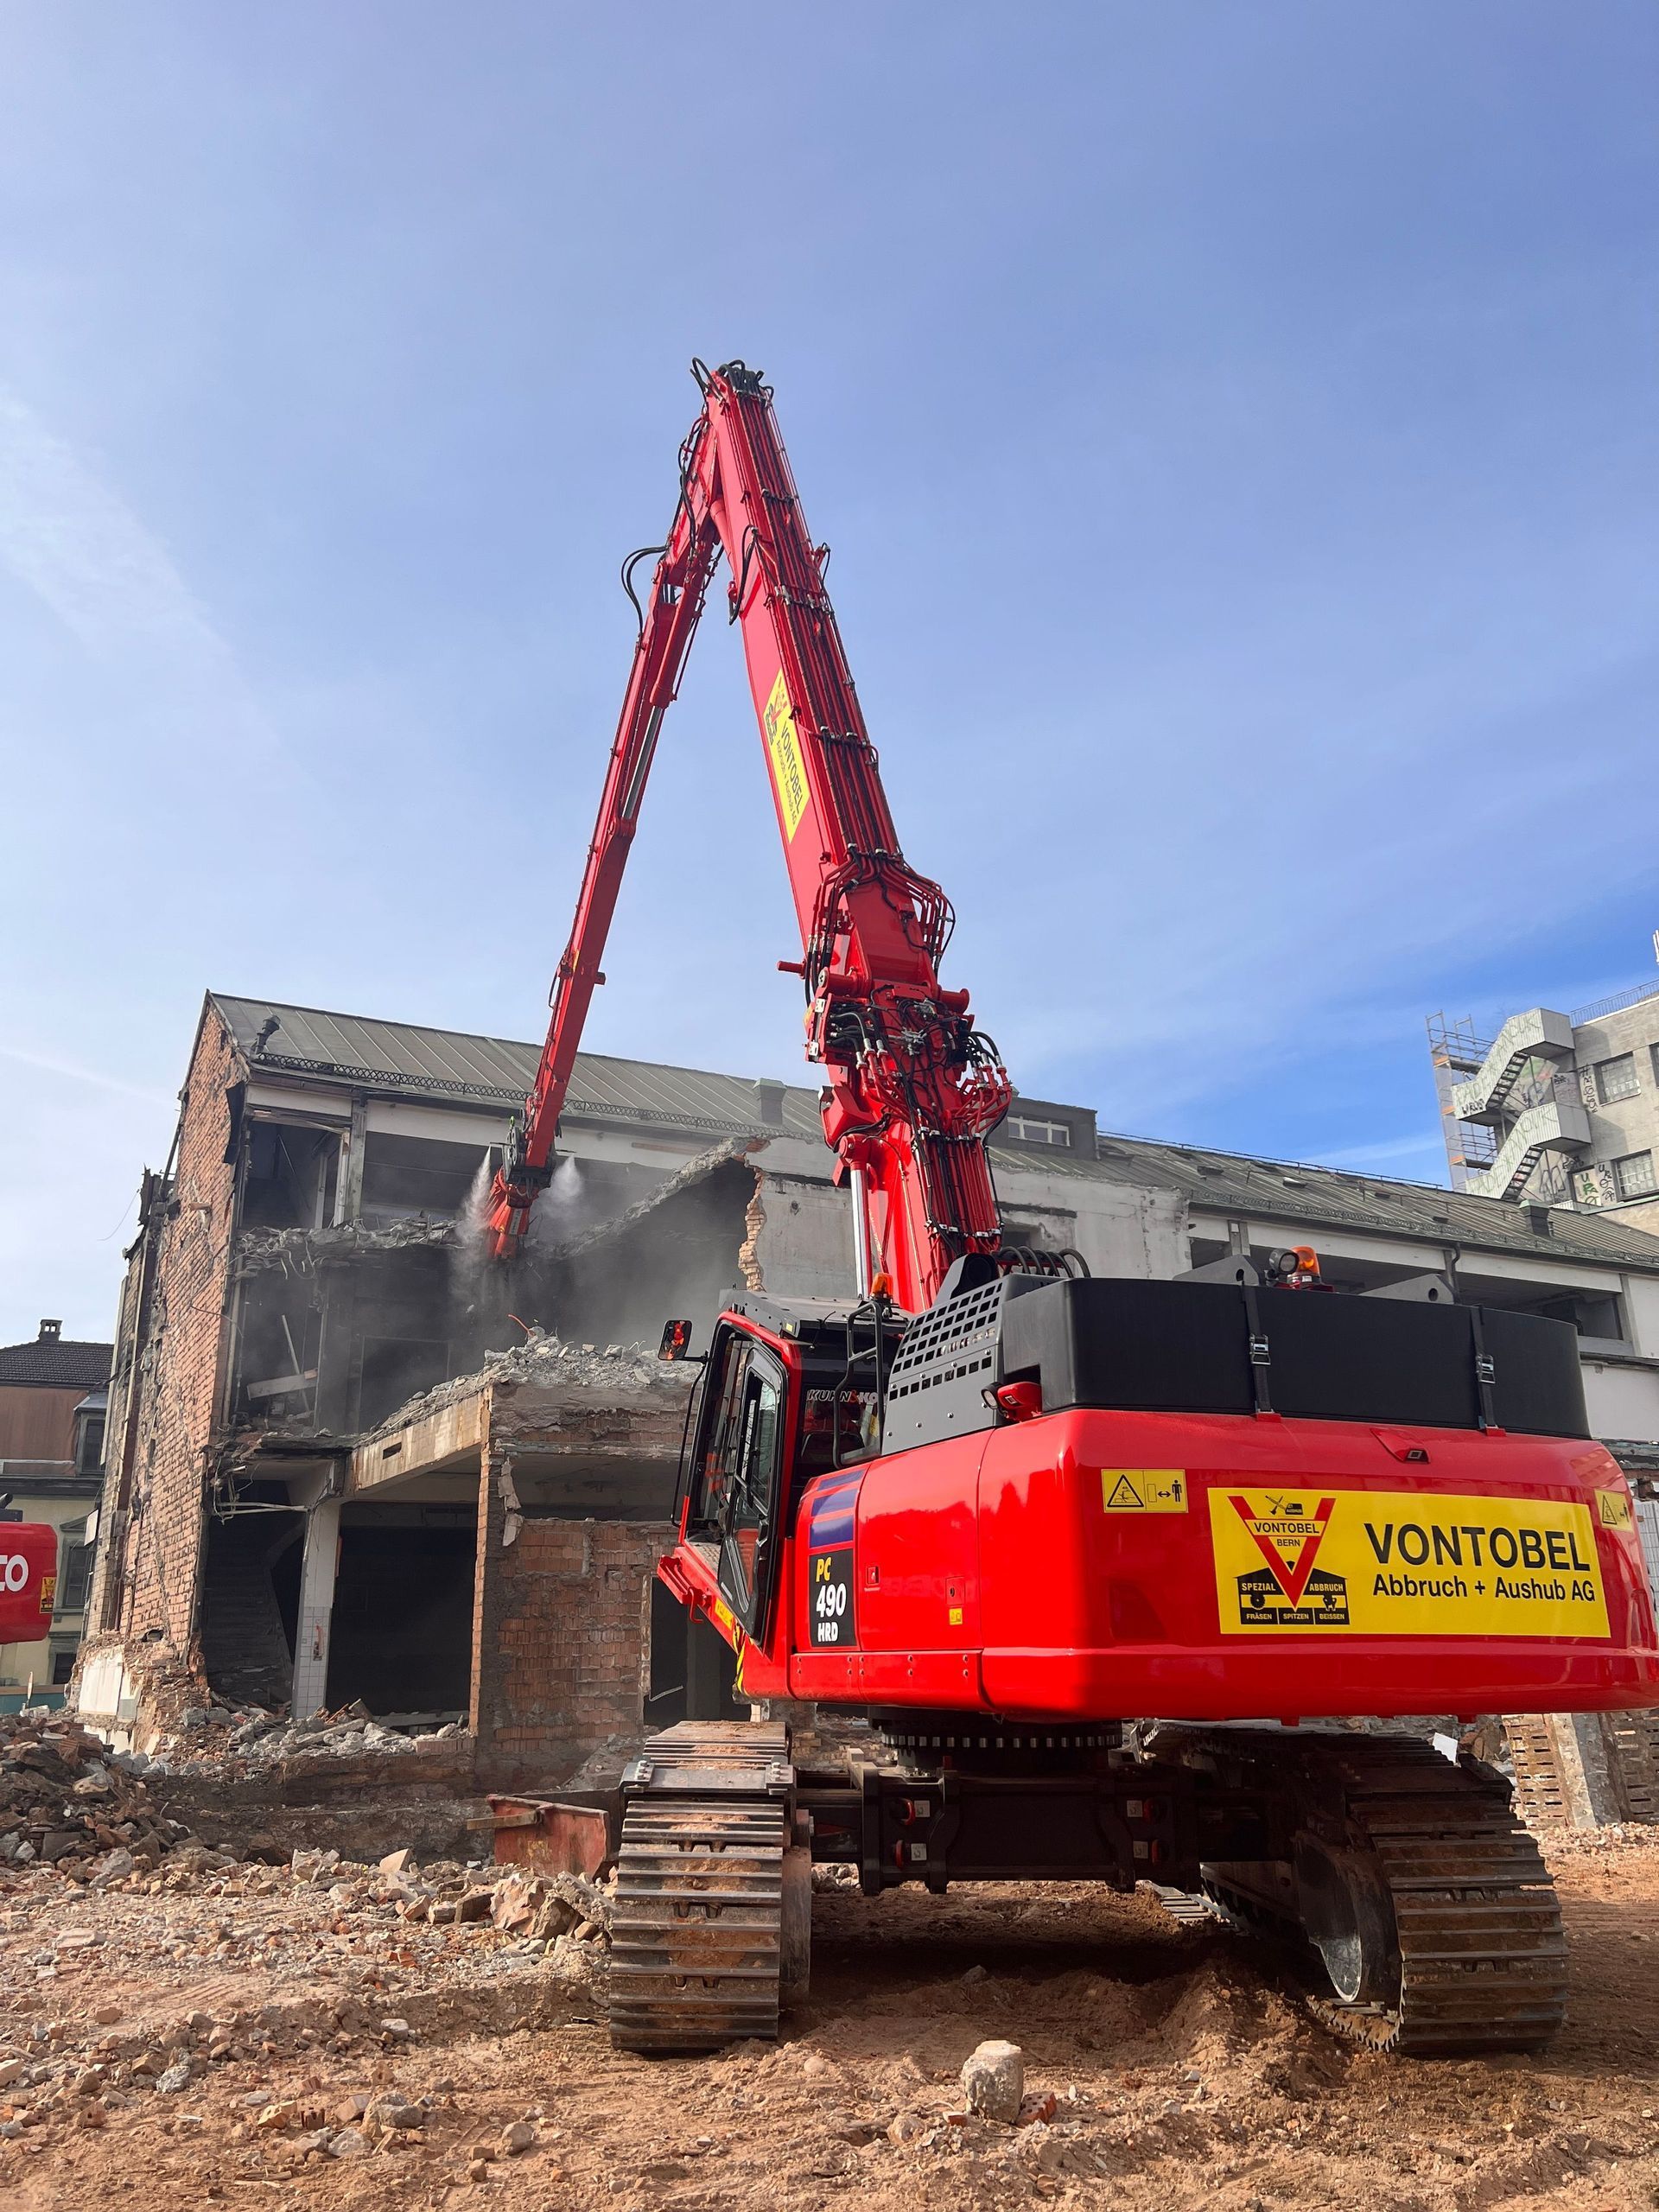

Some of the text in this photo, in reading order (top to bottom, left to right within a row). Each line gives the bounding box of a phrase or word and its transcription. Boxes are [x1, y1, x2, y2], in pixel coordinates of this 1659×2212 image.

[781, 721, 803, 814] VONTOBEL
[1254, 1522, 1319, 1534] VONTOBEL
[1363, 1523, 1591, 1572] VONTOBEL
[816, 1557, 831, 1582] PC
[1309, 1583, 1344, 1592] ABBRUCH
[1373, 1573, 1595, 1601] Abbruch + Aushub AG
[817, 1583, 847, 1618] 490
[817, 1622, 838, 1642] HRD
